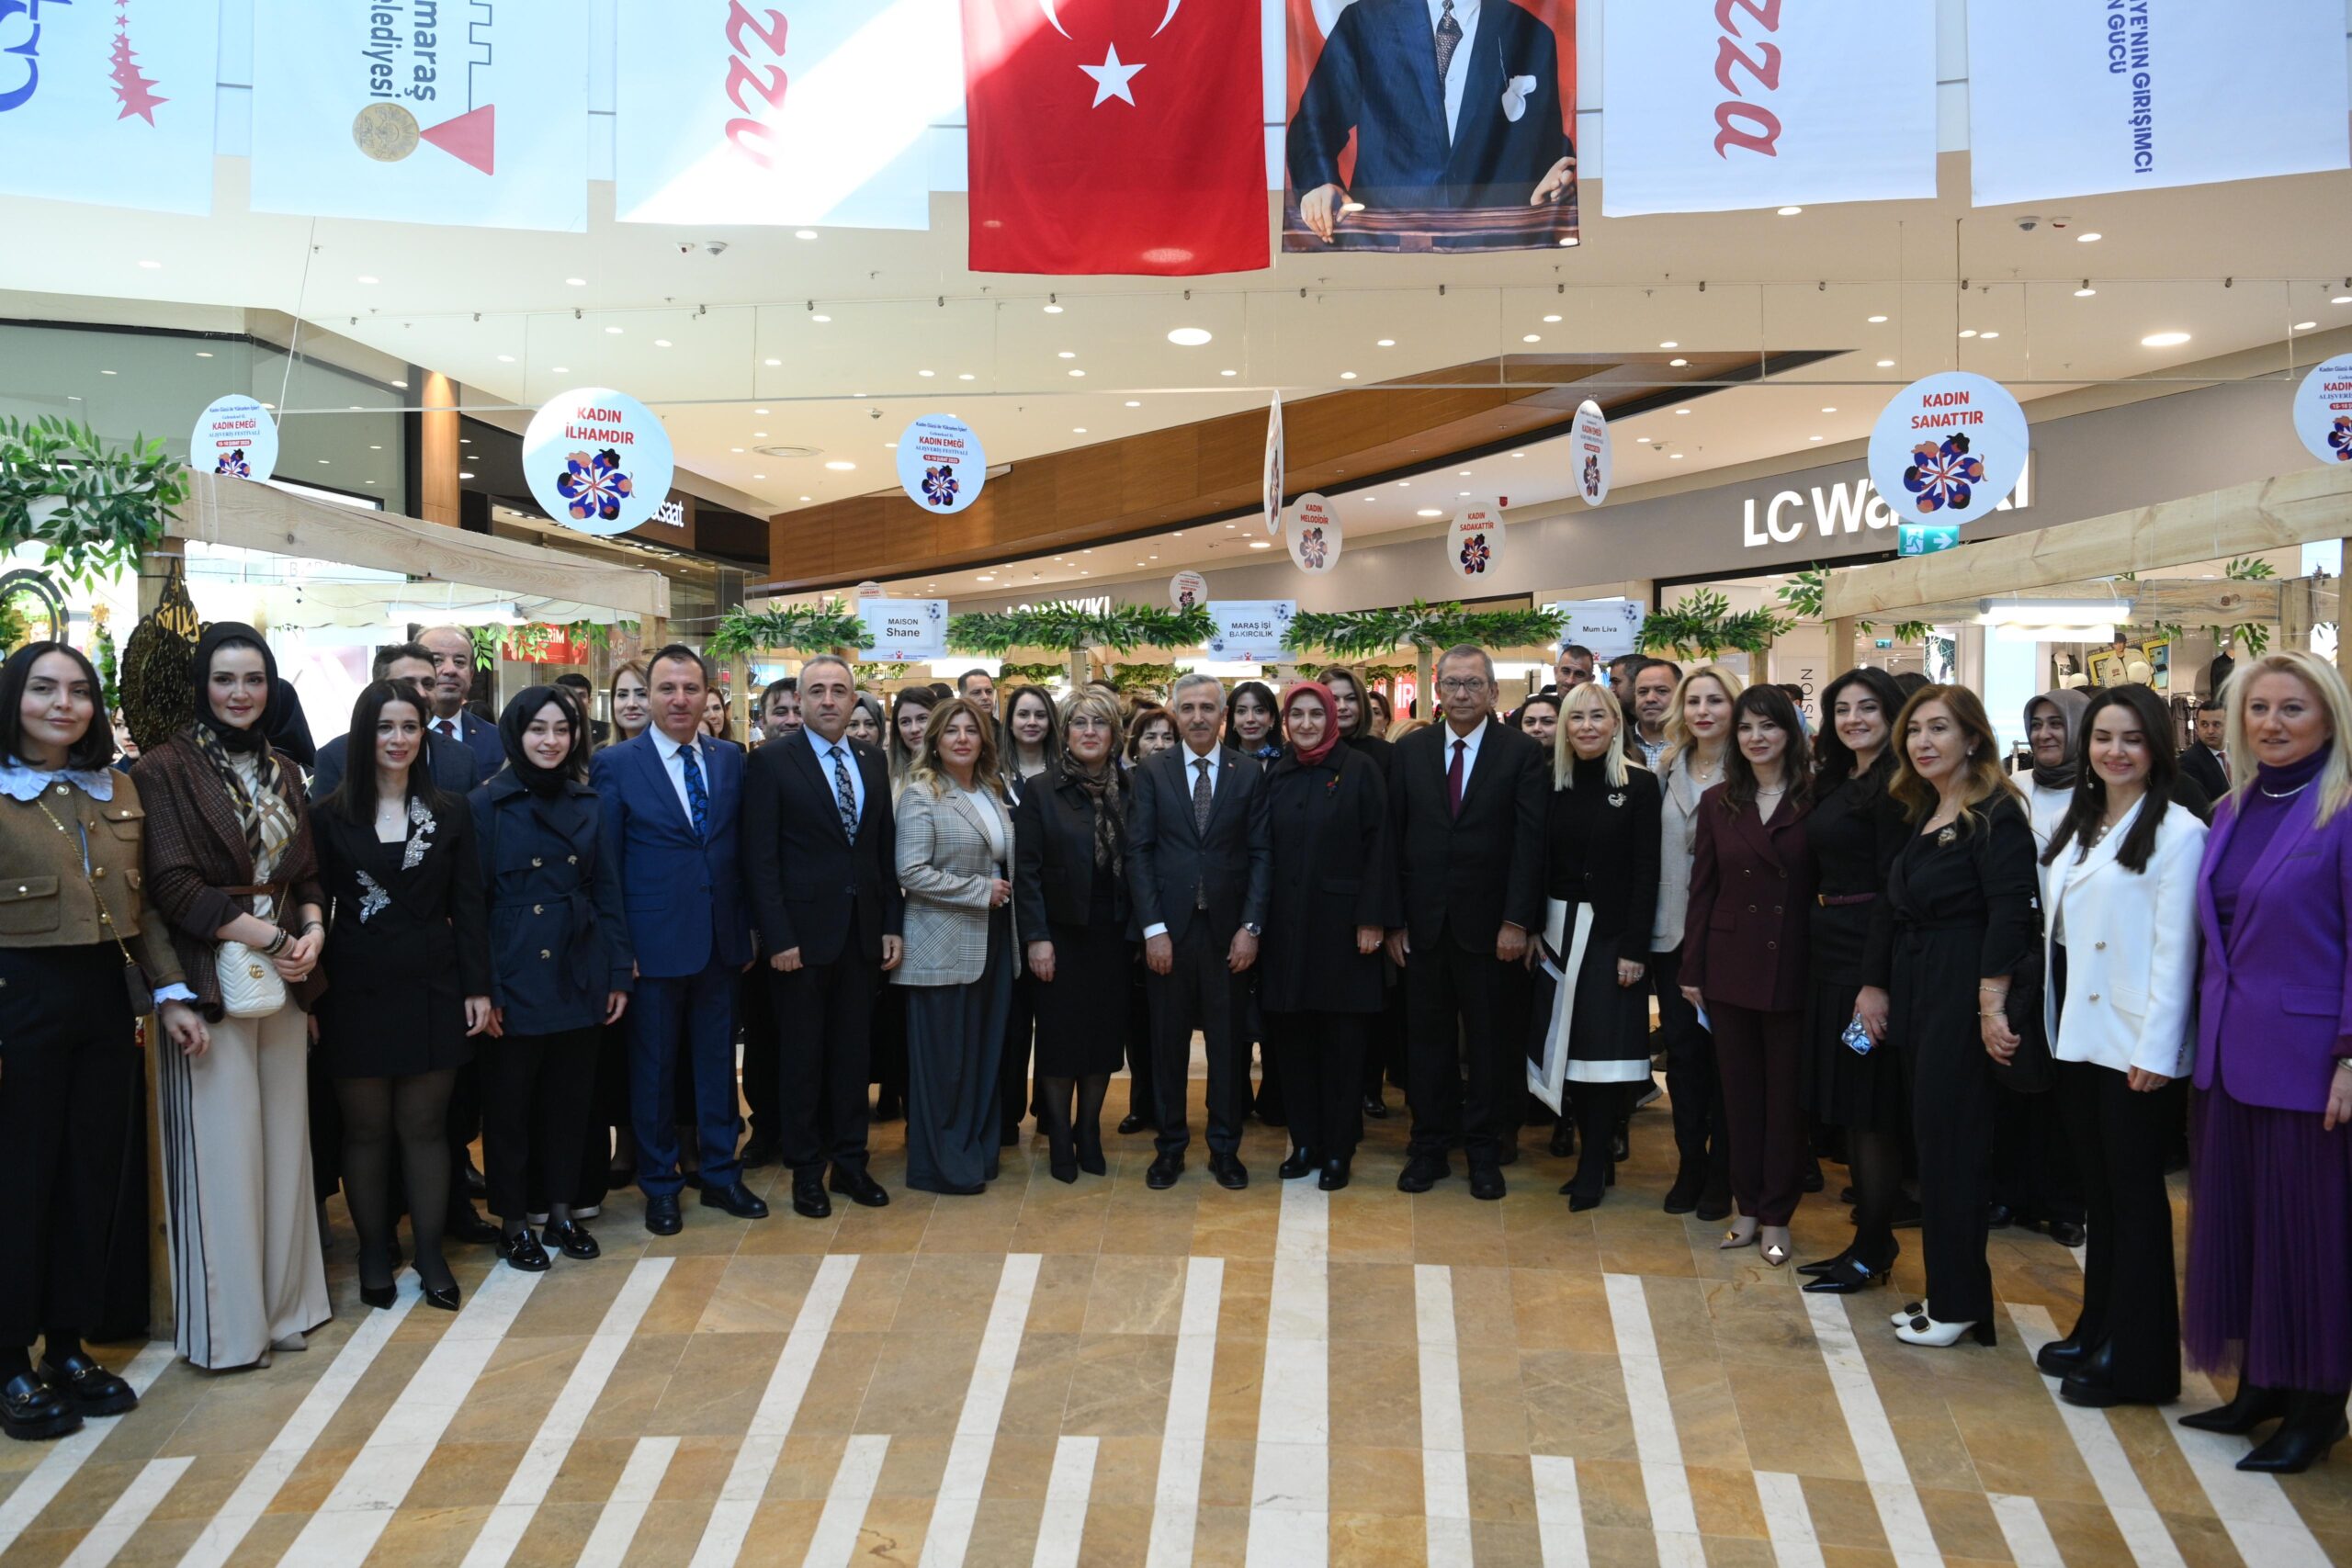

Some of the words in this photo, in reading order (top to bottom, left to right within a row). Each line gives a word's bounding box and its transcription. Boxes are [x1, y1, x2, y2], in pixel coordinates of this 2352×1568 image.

[2129, 0, 2149, 69] YE'NİN
[362, 0, 403, 98] lediyesi
[2128, 72, 2153, 174] GİRİŞİMCİ
[1922, 390, 1970, 408] KADIN
[577, 407, 622, 423] KADIN
[1910, 410, 1984, 430] SANATTIR
[212, 421, 234, 431] KADIN
[235, 418, 256, 430] EMEĞİ
[565, 422, 634, 445] İLHAMDIR
[919, 435, 942, 446] KADIN
[943, 438, 965, 448] EMEĞİ
[1306, 503, 1323, 513] KADIN
[1467, 512, 1486, 520] KADIN
[1300, 513, 1329, 525] MELODİDİR
[1744, 491, 1804, 547] LC
[887, 627, 920, 637] Shane
[1261, 621, 1272, 630] İŞİ
